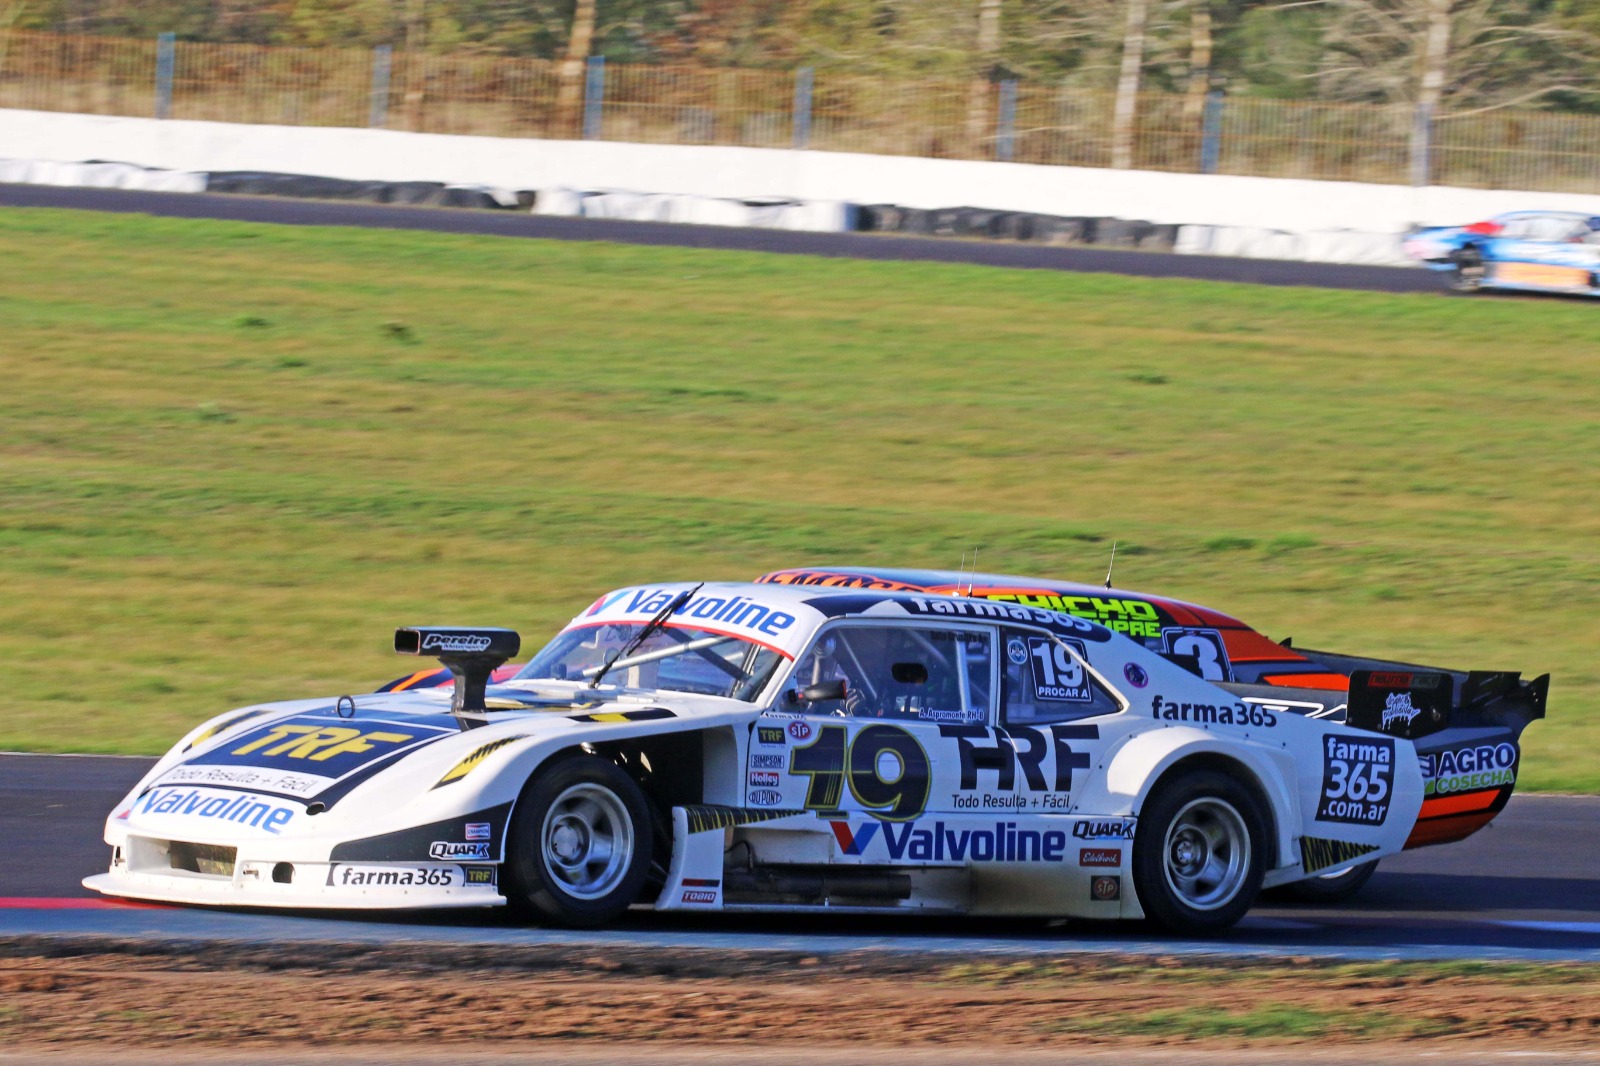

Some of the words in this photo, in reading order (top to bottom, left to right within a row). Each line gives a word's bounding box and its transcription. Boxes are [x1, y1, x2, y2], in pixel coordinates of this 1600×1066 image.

[910, 597, 1093, 632] farma365
[1032, 643, 1083, 687] 19
[1038, 686, 1079, 698] PROCAR
[1081, 689, 1088, 698] A
[1151, 694, 1277, 728] farma365
[760, 730, 782, 740] TRF
[791, 724, 809, 738] STP
[231, 724, 414, 761] TRF
[1328, 737, 1390, 763] farma
[753, 755, 781, 763] SIMPSON
[937, 724, 1100, 792] TRF
[1438, 744, 1515, 777] AGRO
[168, 767, 203, 781] Todo
[203, 768, 259, 784] Resulta
[751, 773, 778, 786] Holley
[788, 723, 932, 822] 19
[1326, 760, 1389, 802] 365
[1437, 768, 1514, 793] COSECHA
[952, 794, 979, 808] Todo
[983, 793, 1027, 808] Resulta
[1042, 793, 1070, 808] Fácil
[1322, 800, 1386, 821] .com.ar
[142, 788, 294, 836] Valvoline
[1072, 820, 1136, 840] QUARK
[430, 843, 489, 858] QUARK
[881, 821, 1066, 862] Valvoline
[342, 867, 453, 886] farma365
[469, 870, 491, 881] TRF
[1097, 880, 1114, 894] STP
